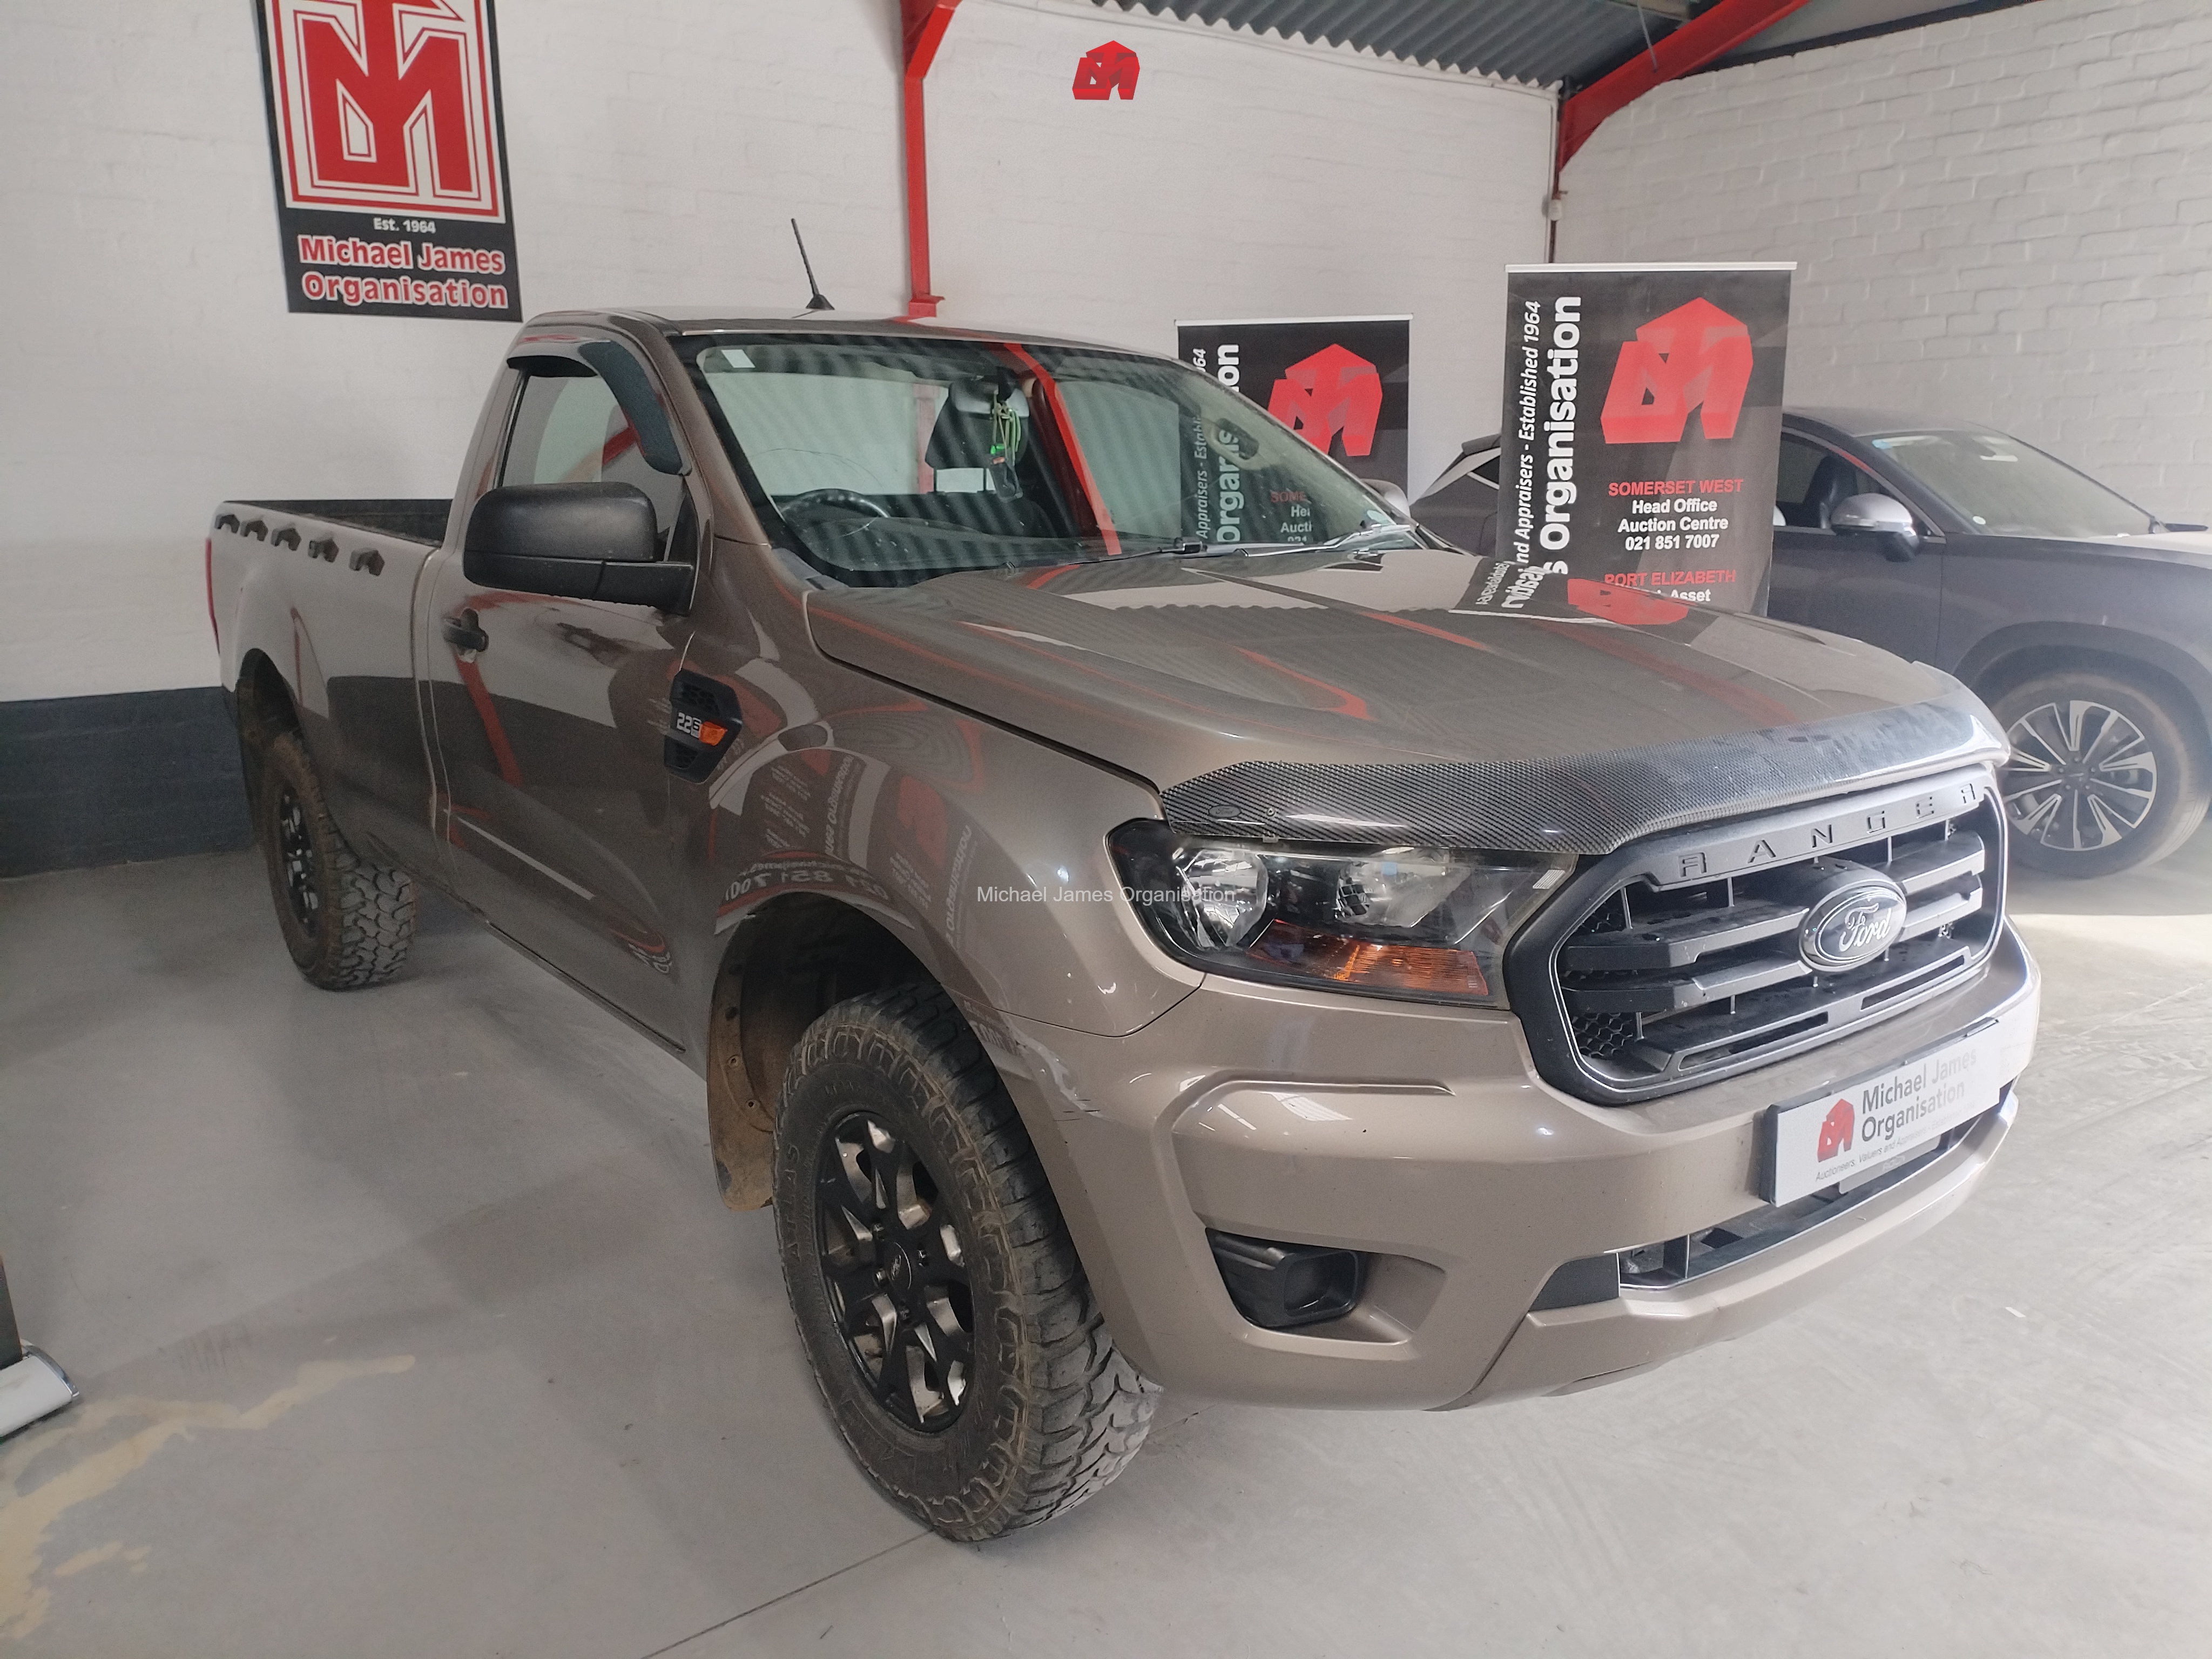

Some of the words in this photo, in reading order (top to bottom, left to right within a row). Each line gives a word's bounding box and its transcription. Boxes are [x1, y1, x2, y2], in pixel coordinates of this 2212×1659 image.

[373, 218, 400, 232] Est.
[403, 219, 436, 234] 1964
[298, 234, 413, 269] Michael
[417, 242, 505, 275] James
[302, 271, 509, 309] Organisation
[1523, 300, 1541, 342] 1964
[1519, 347, 1538, 441] Established
[1539, 296, 1581, 550] Organisation
[1514, 454, 1534, 539] Appraisers
[1608, 480, 1696, 496] SOMERSET
[1699, 478, 1744, 493] WEST
[1632, 498, 1670, 514] Head
[1674, 498, 1718, 512] Office
[1618, 517, 1676, 533] Auction
[1680, 516, 1729, 530] Centre
[1624, 536, 1651, 550] 021
[1654, 535, 1681, 549] 851
[1684, 534, 1720, 548] 7007
[1513, 542, 1530, 564] nd
[1604, 572, 1648, 587] PORT
[1651, 569, 1736, 586] ELIZABETH
[1670, 588, 1711, 602] Asset
[1677, 783, 1977, 879] RANGER
[1838, 901, 1891, 952] Ford
[1862, 1064, 1927, 1115] Michael
[1932, 1048, 1977, 1084] James
[1862, 1080, 1966, 1143] Organisation
